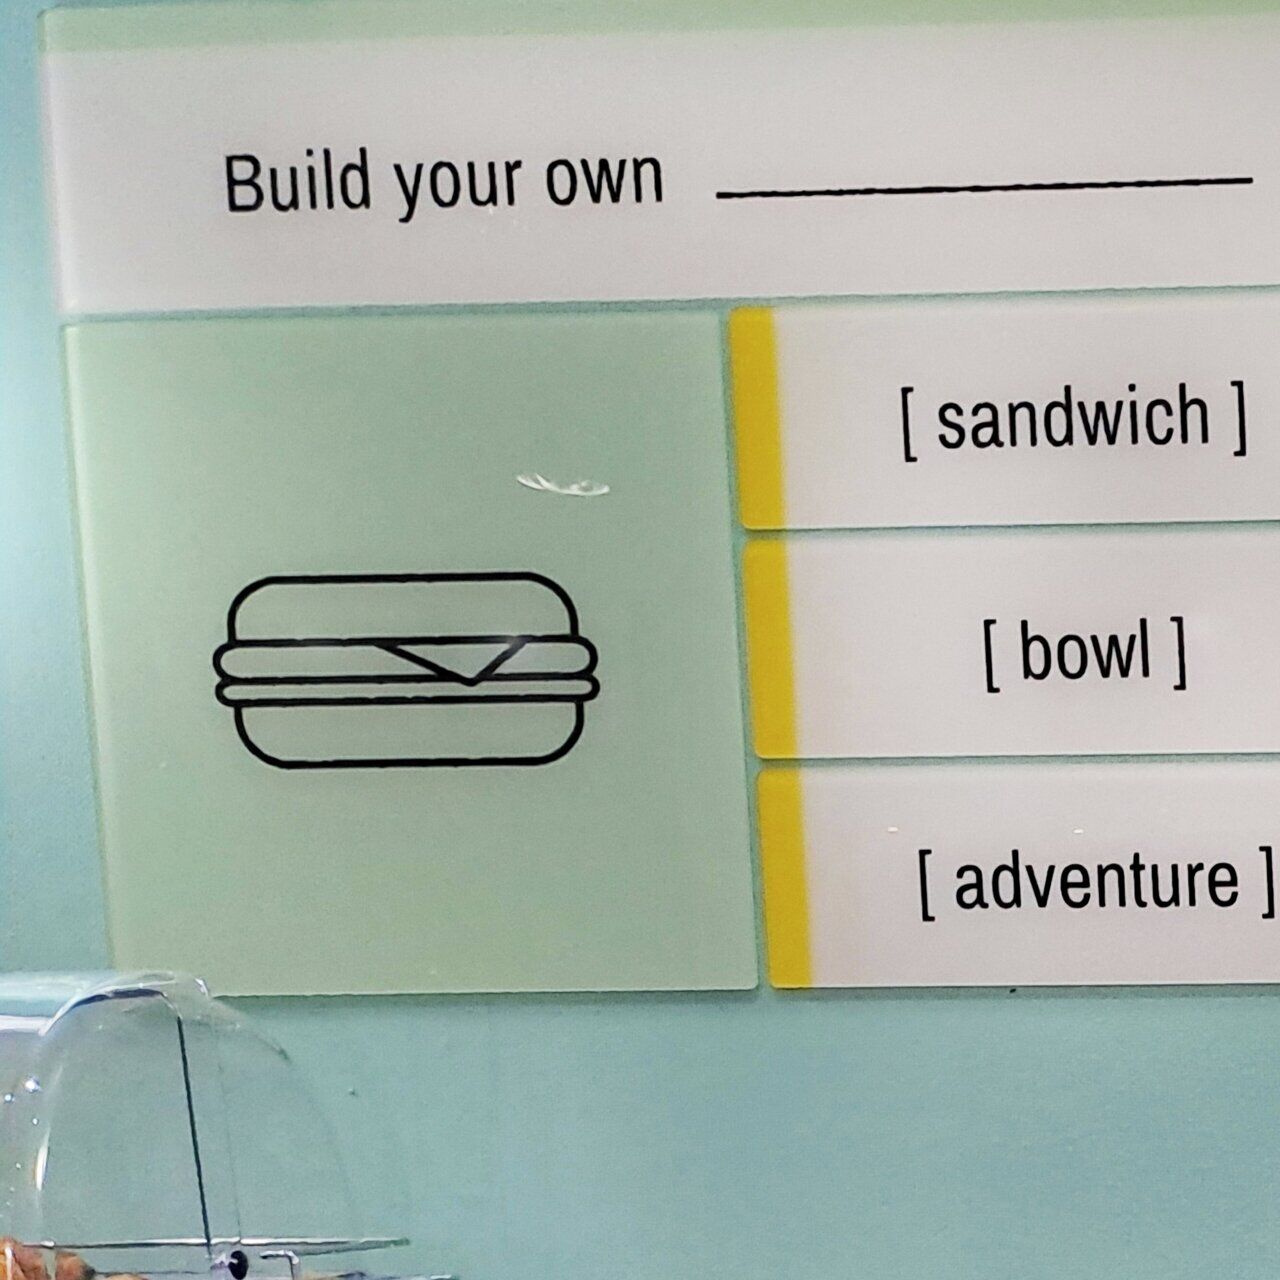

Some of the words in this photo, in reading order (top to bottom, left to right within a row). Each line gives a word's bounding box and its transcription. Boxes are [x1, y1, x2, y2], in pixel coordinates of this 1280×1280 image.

[225, 146, 371, 213] Build
[393, 159, 523, 224] your
[546, 157, 663, 206] own
